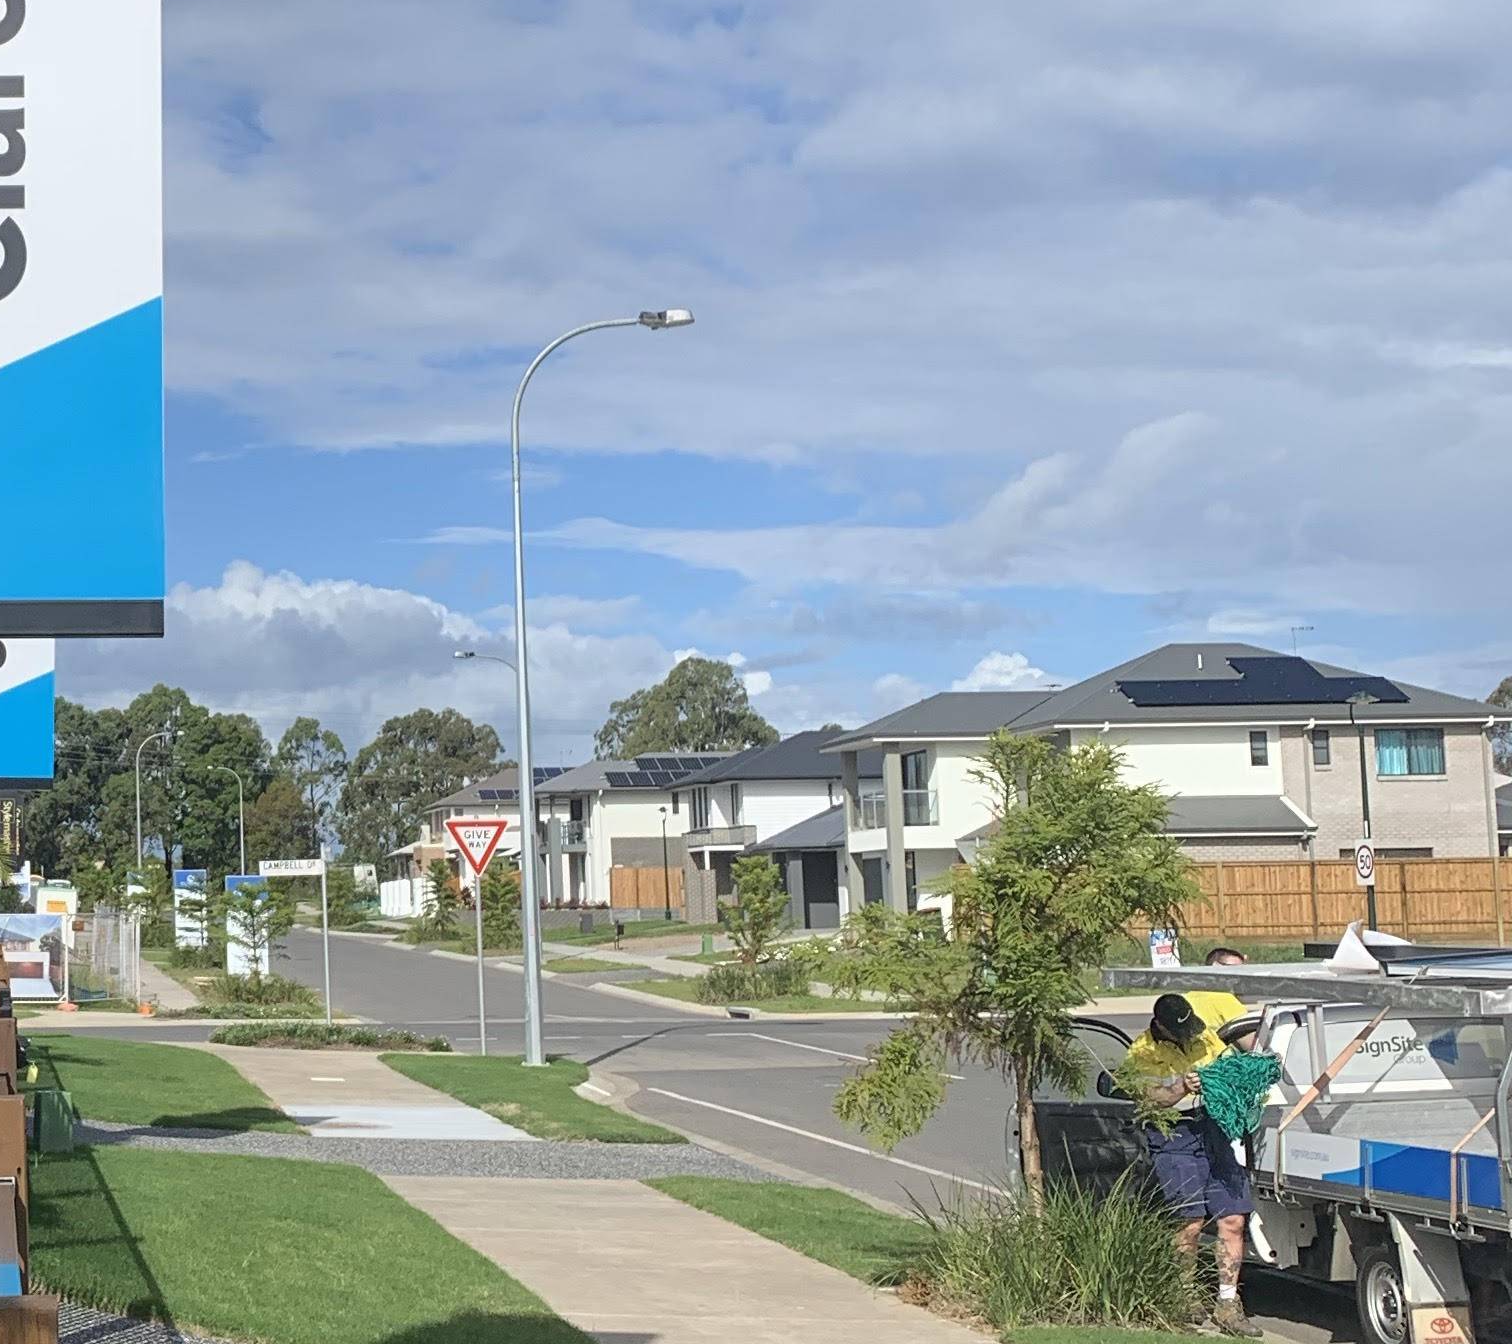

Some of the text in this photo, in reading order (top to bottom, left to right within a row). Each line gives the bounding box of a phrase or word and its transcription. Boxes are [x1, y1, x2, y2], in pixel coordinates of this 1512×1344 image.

[464, 830, 491, 839] GIVE
[263, 860, 303, 870] CAMPBELL
[1359, 854, 1371, 869] 50
